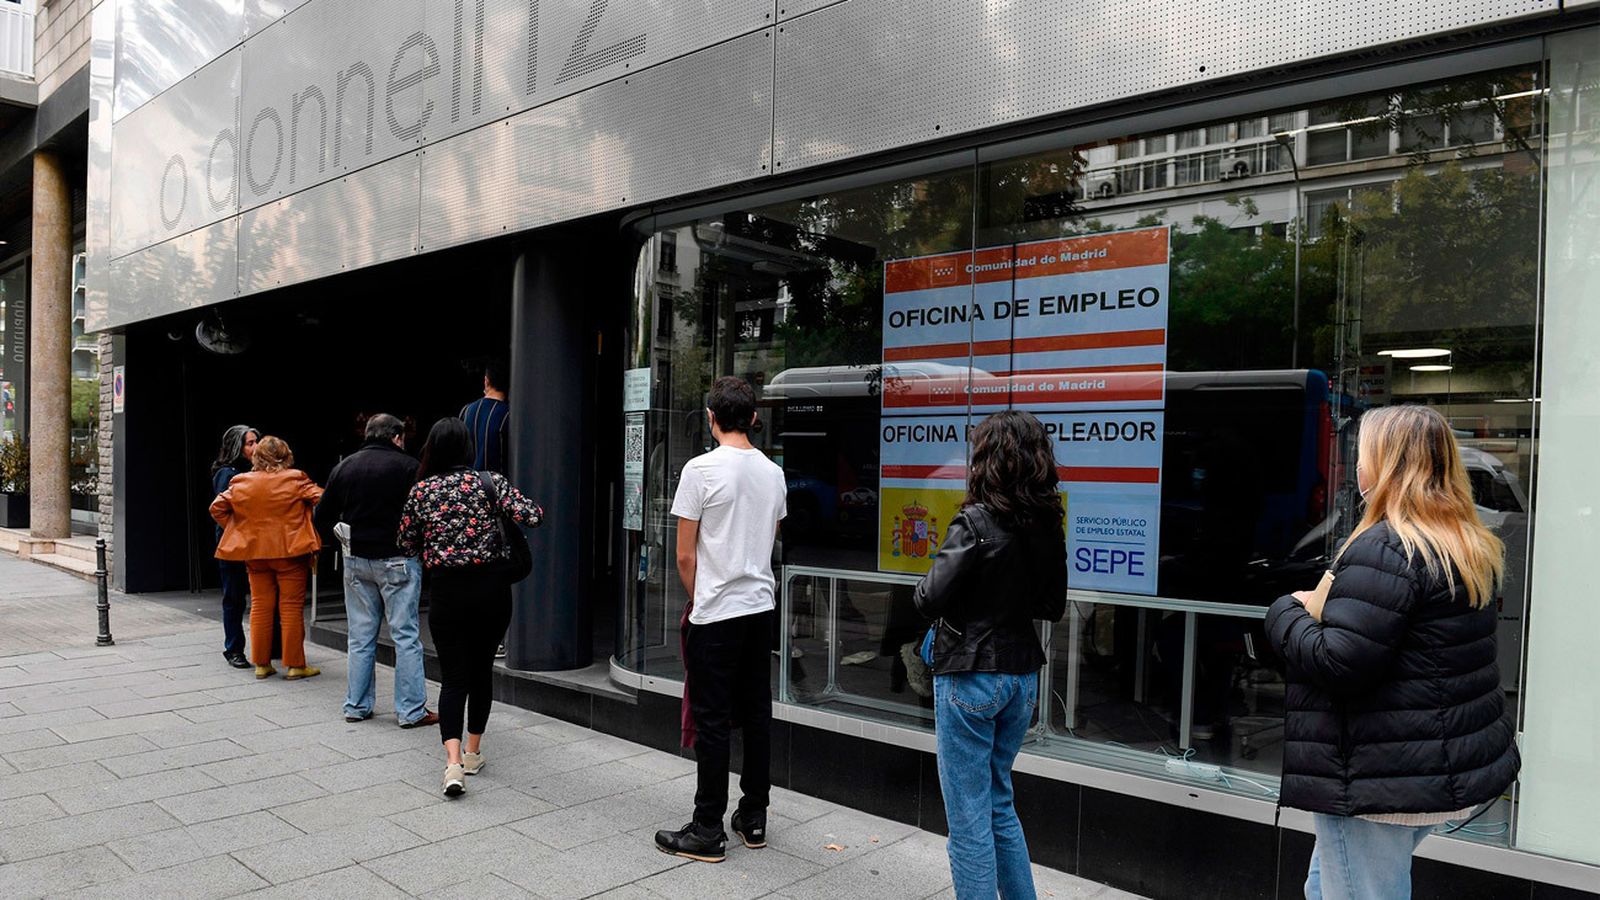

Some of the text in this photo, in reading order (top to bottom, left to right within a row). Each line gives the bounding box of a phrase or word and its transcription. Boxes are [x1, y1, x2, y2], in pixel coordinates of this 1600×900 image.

[965, 249, 1107, 273] Comunidad de Madrid
[888, 287, 1160, 328] OFICINA DE EMPLEO
[963, 380, 1105, 393] Comunidad de Madrid
[883, 424, 958, 443] OFICINA
[1047, 422, 1156, 442] PLEADOR
[1076, 516, 1146, 526] SERVICIO PÚBLICO
[1116, 529, 1146, 537] ESTATAL
[1075, 547, 1145, 576] SEPE
